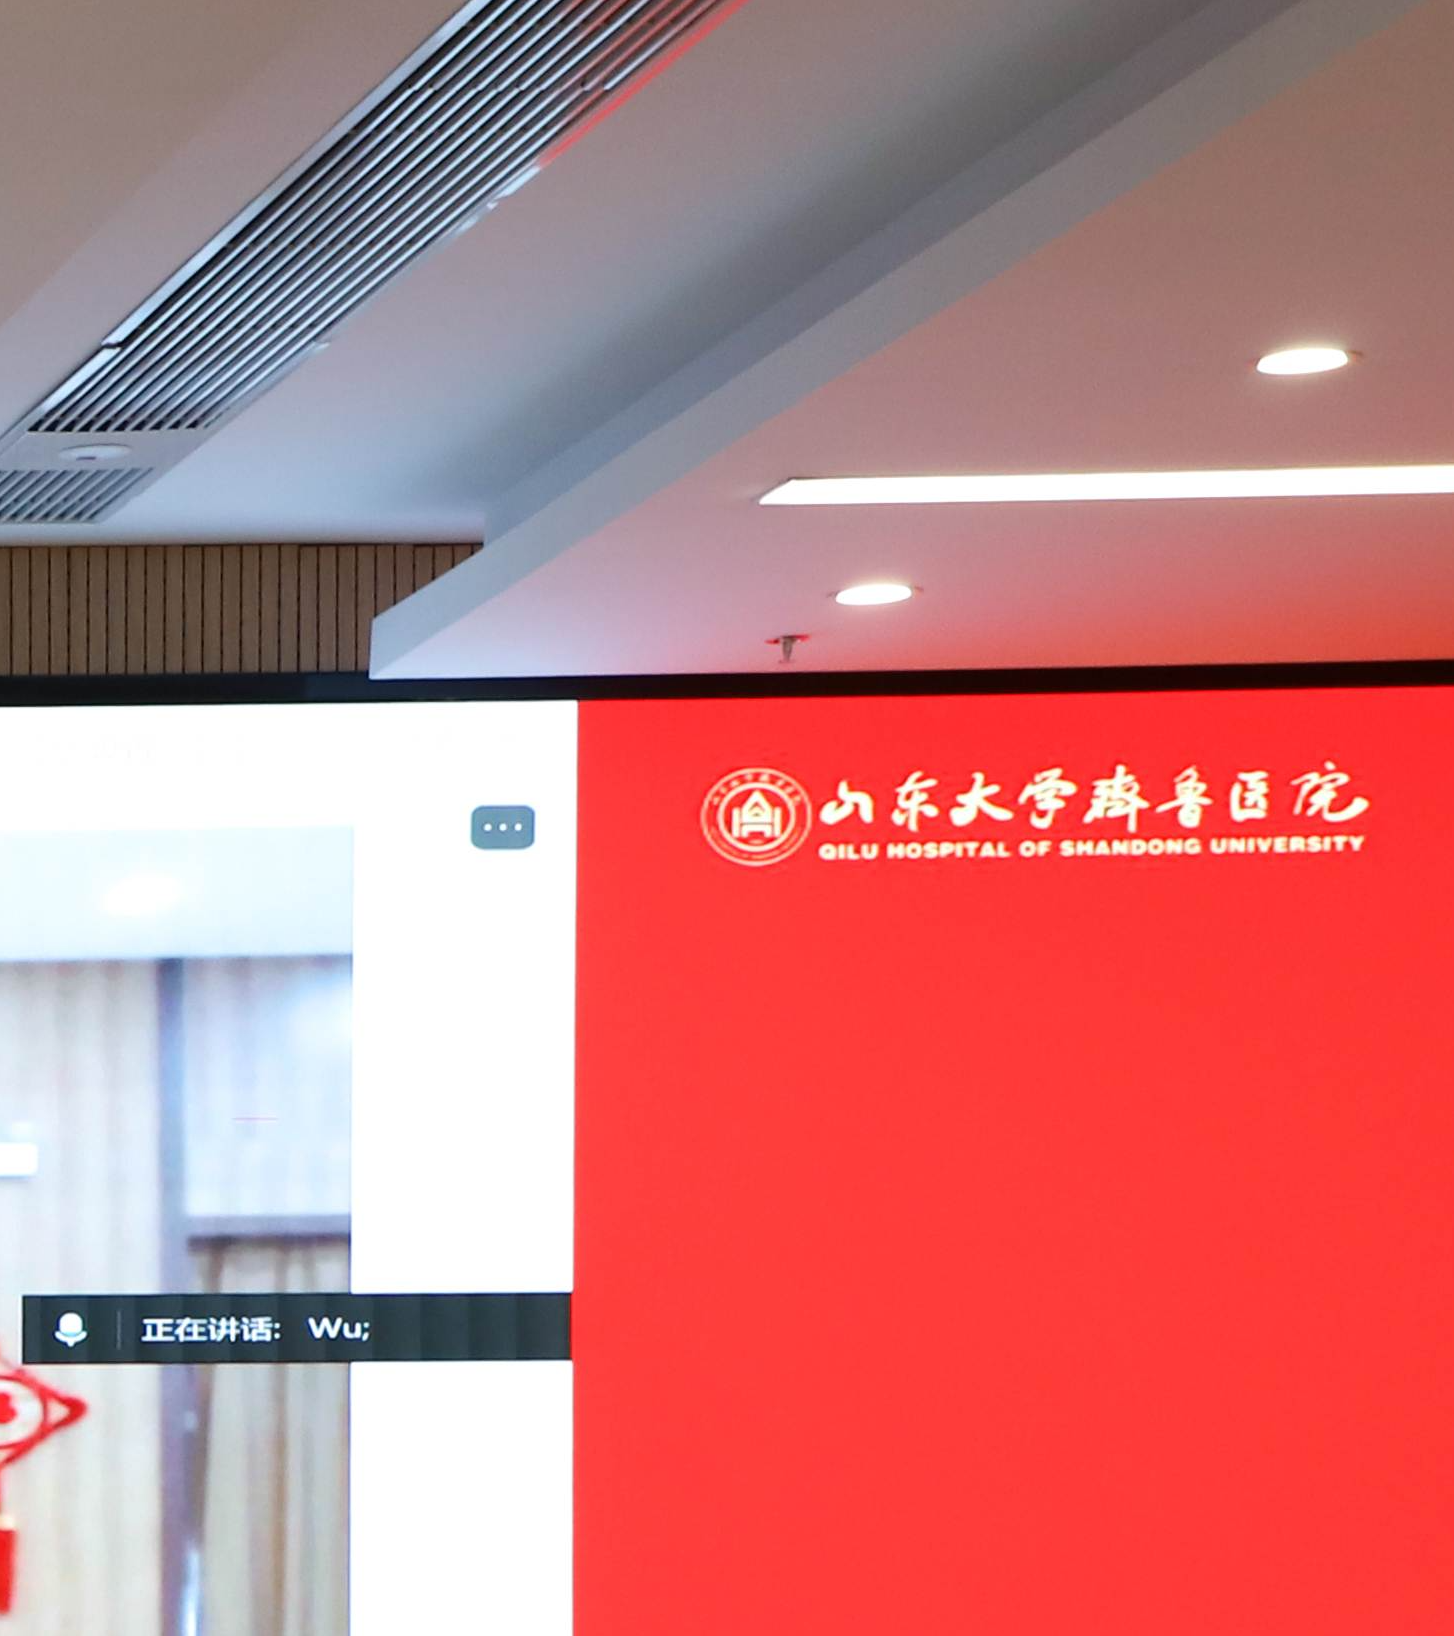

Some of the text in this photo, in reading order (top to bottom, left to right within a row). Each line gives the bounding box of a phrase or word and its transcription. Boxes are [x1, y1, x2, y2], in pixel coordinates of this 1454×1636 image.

[818, 843, 879, 861] QILU
[886, 841, 1011, 860] HOSPITAL
[1019, 840, 1052, 858] OF
[1060, 838, 1202, 857] SHANDONG
[1210, 835, 1365, 855] UNIVERSITY
